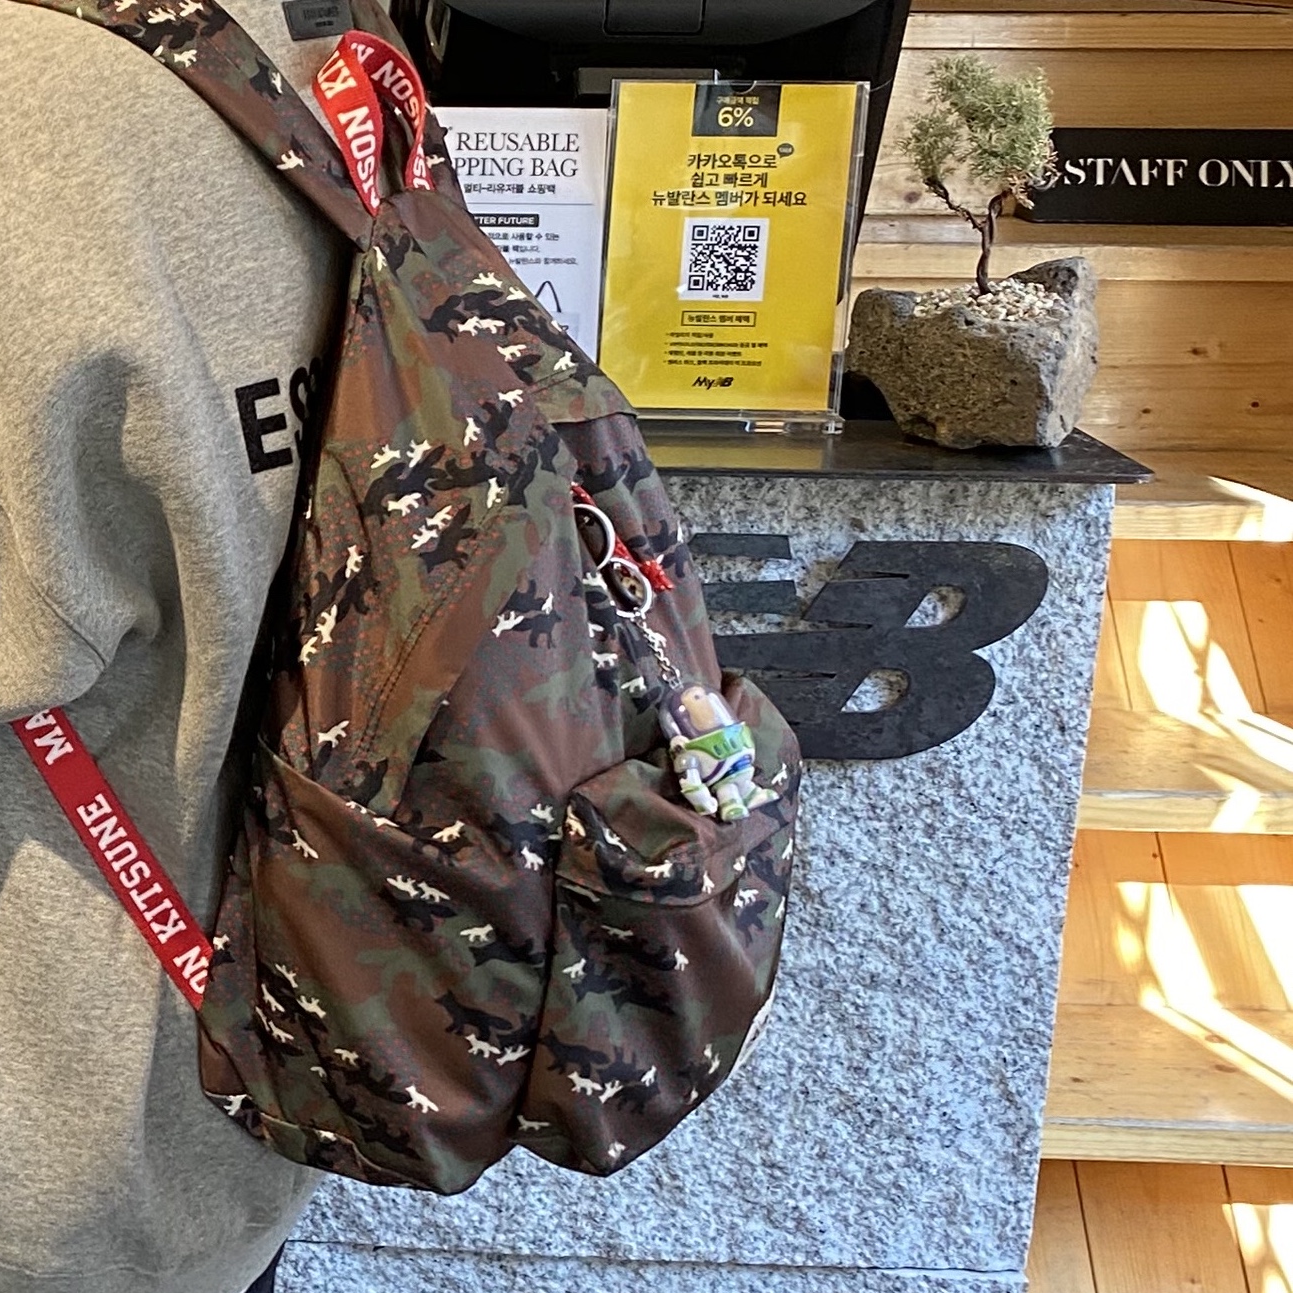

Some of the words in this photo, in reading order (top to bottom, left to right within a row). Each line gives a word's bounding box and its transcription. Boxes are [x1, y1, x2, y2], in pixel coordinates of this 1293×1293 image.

[718, 107, 754, 127] 6%
[455, 132, 580, 152] REUSABLE
[530, 158, 578, 177] BAG
[687, 154, 777, 170] 카카오톡으로
[691, 172, 720, 188] 쉽고
[723, 172, 768, 188] 빠르게
[1063, 158, 1188, 187] STAFF
[1198, 158, 1293, 188] ONLY
[652, 191, 710, 207] 뉴발란스
[715, 191, 759, 207] 멤버가
[762, 191, 807, 207] 되세요
[498, 217, 535, 225] FUTURE
[76, 793, 186, 944] KITSUNE
